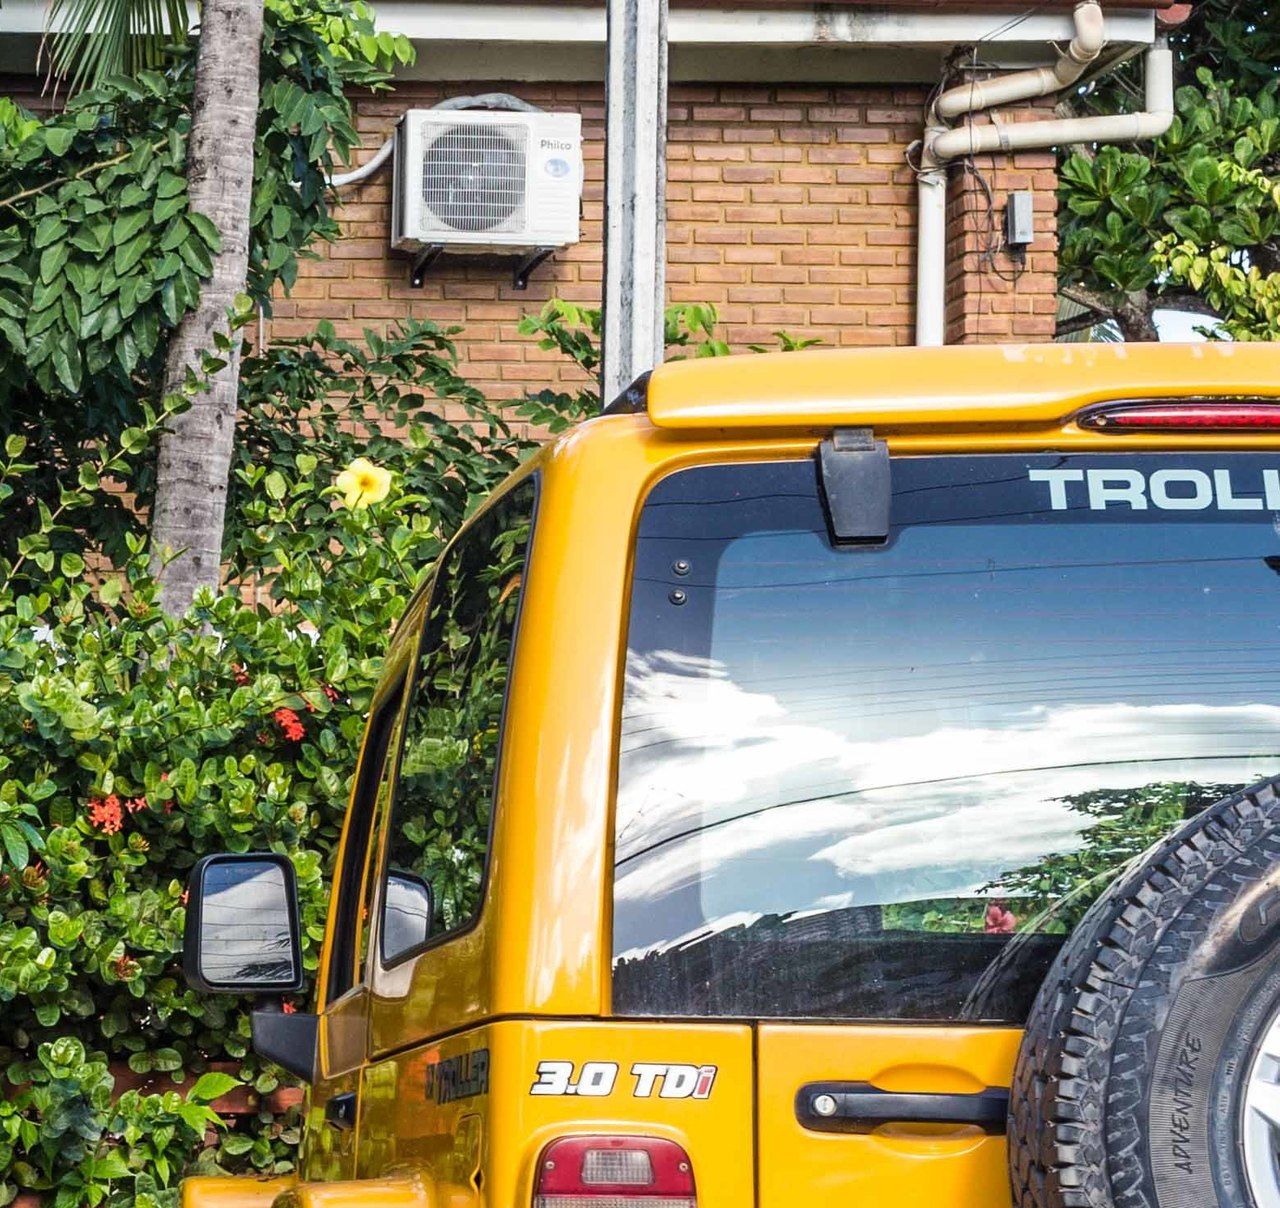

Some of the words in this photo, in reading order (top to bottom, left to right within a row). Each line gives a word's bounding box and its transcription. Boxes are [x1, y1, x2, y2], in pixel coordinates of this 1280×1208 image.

[540, 139, 571, 150] Philco
[529, 1061, 620, 1096] 3.0
[1170, 1032, 1202, 1174] ADVENTURE
